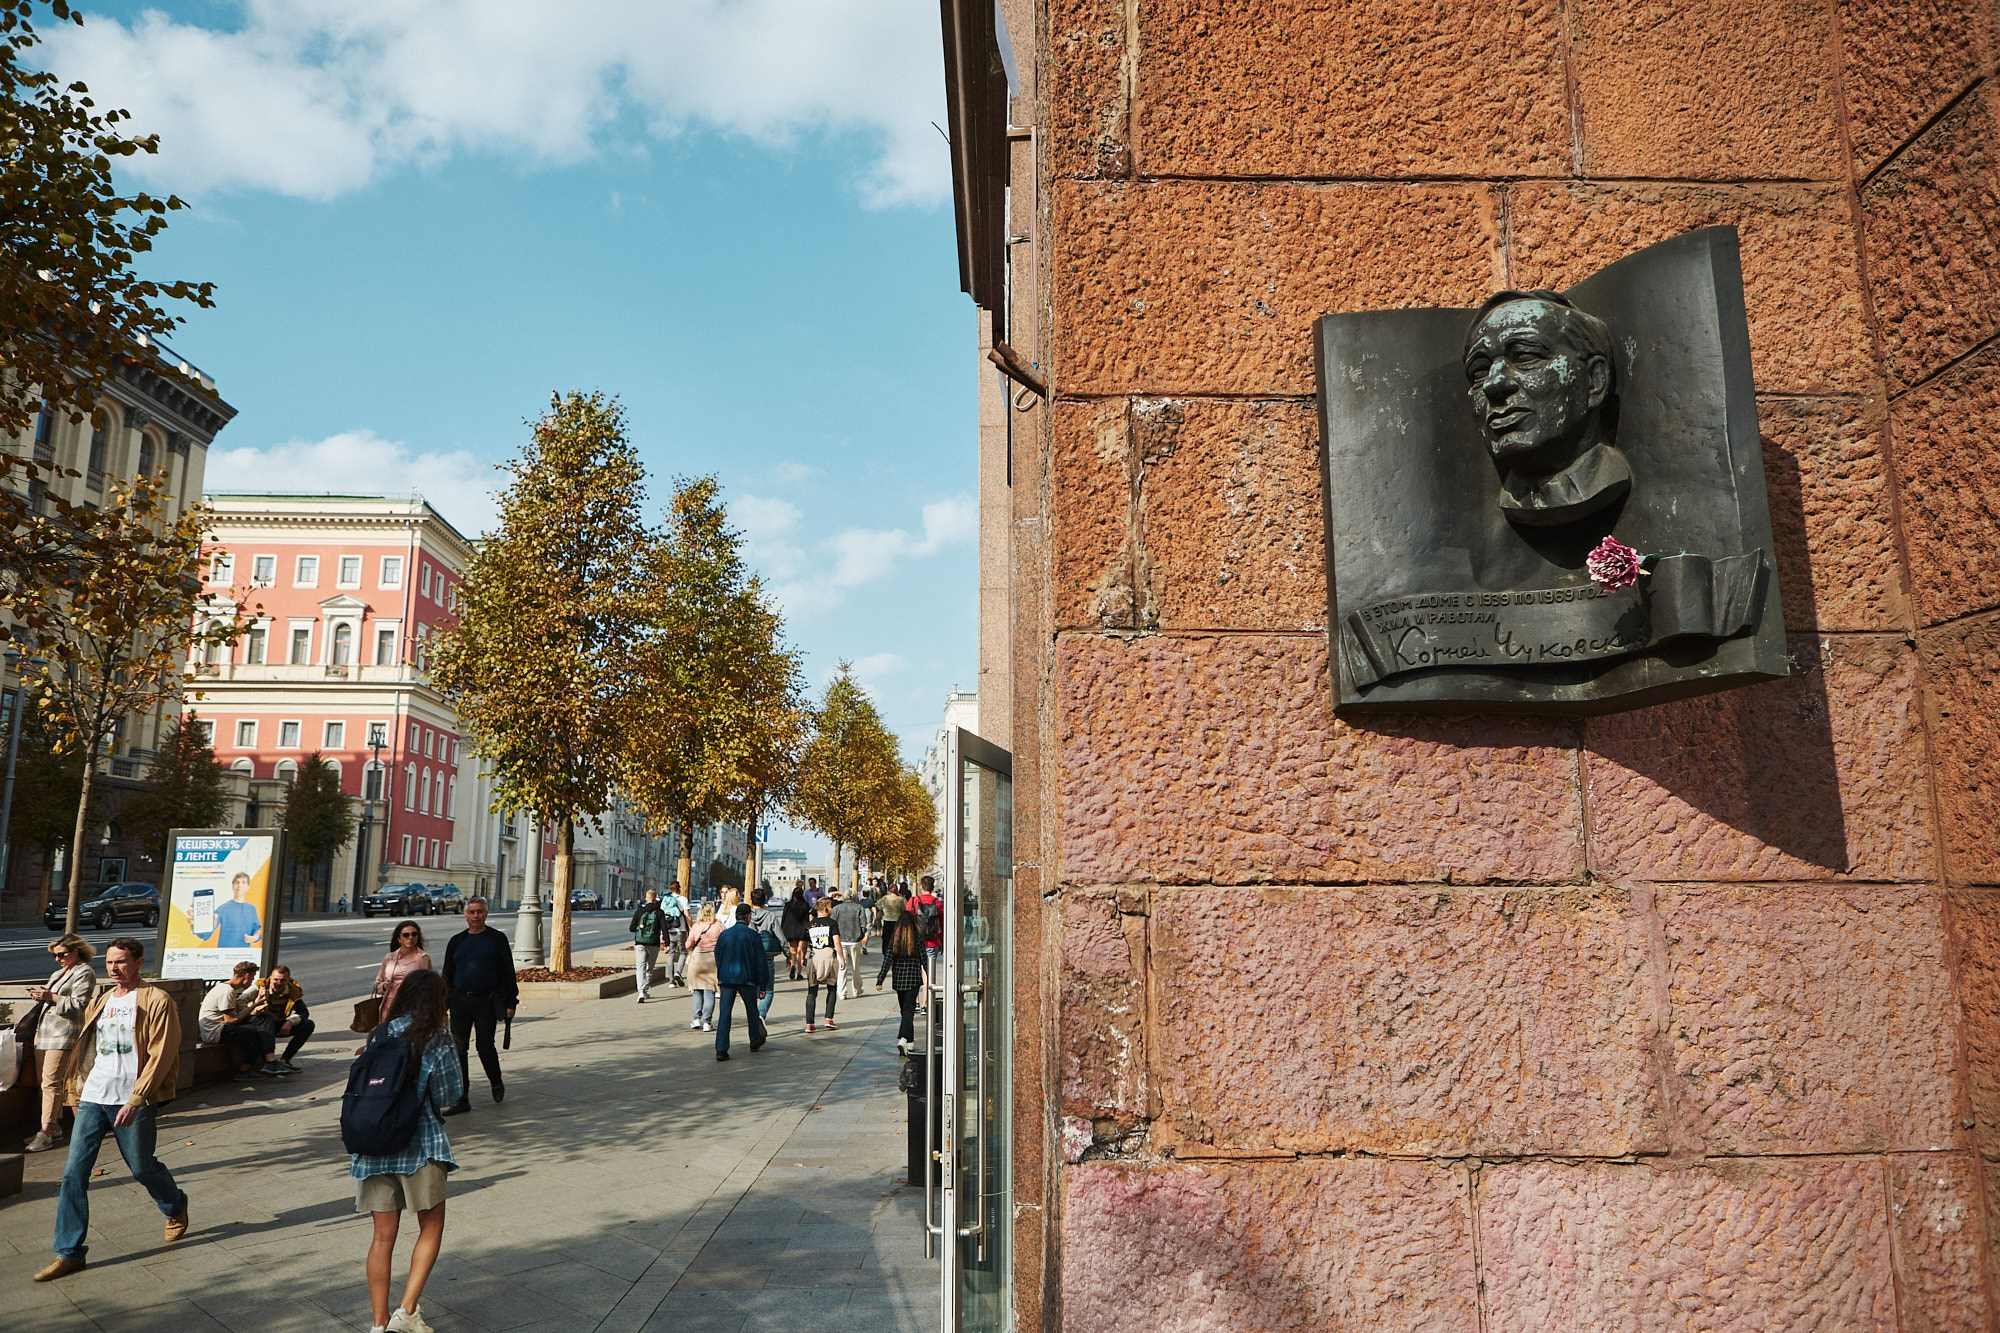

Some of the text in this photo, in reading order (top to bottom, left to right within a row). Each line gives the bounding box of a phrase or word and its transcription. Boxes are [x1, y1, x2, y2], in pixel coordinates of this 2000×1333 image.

[1361, 610, 1372, 622] В
[1373, 600, 1413, 618] ЭТОМ
[1415, 594, 1459, 609] ДОМЕ
[1463, 593, 1475, 607] С
[1479, 592, 1510, 607] 1939
[1514, 591, 1536, 606] ПО
[1539, 586, 1575, 605] 1969
[1375, 610, 1496, 634] ЖИЛ И РАБОТАЛ
[177, 840, 241, 850] КЕШБЭК 3%
[176, 852, 218, 861] В ЛЕНТЕ
